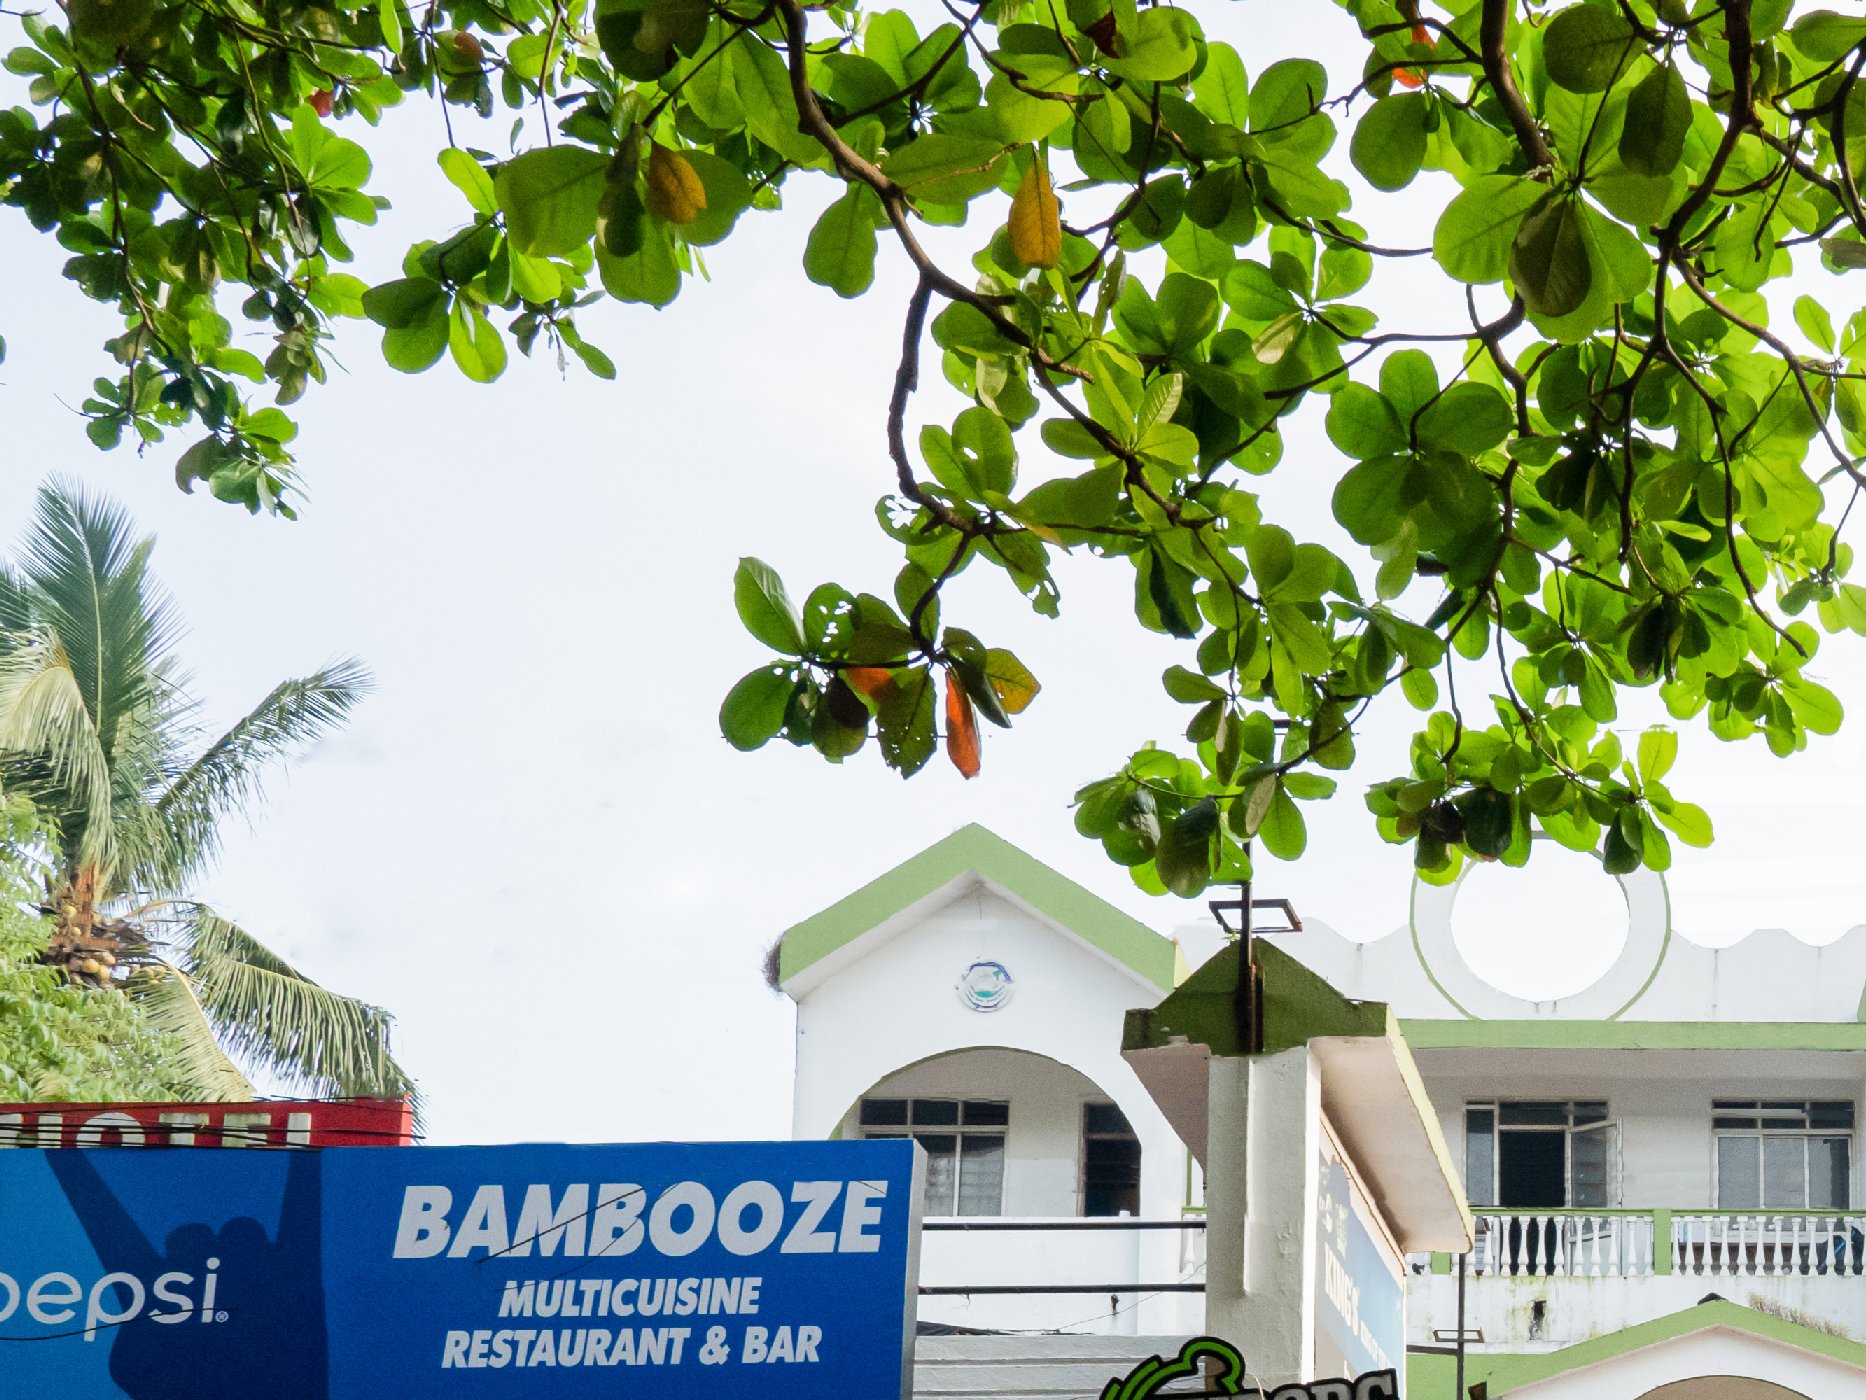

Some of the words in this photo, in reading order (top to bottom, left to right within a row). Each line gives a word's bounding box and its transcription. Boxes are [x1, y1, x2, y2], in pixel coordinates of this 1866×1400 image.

[392, 1181, 889, 1260] BAMBOOZE
[499, 1276, 763, 1320] MULTICUISINE
[441, 1327, 689, 1370] RESTAURANT
[699, 1328, 732, 1366] &
[742, 1325, 824, 1366] BAR
